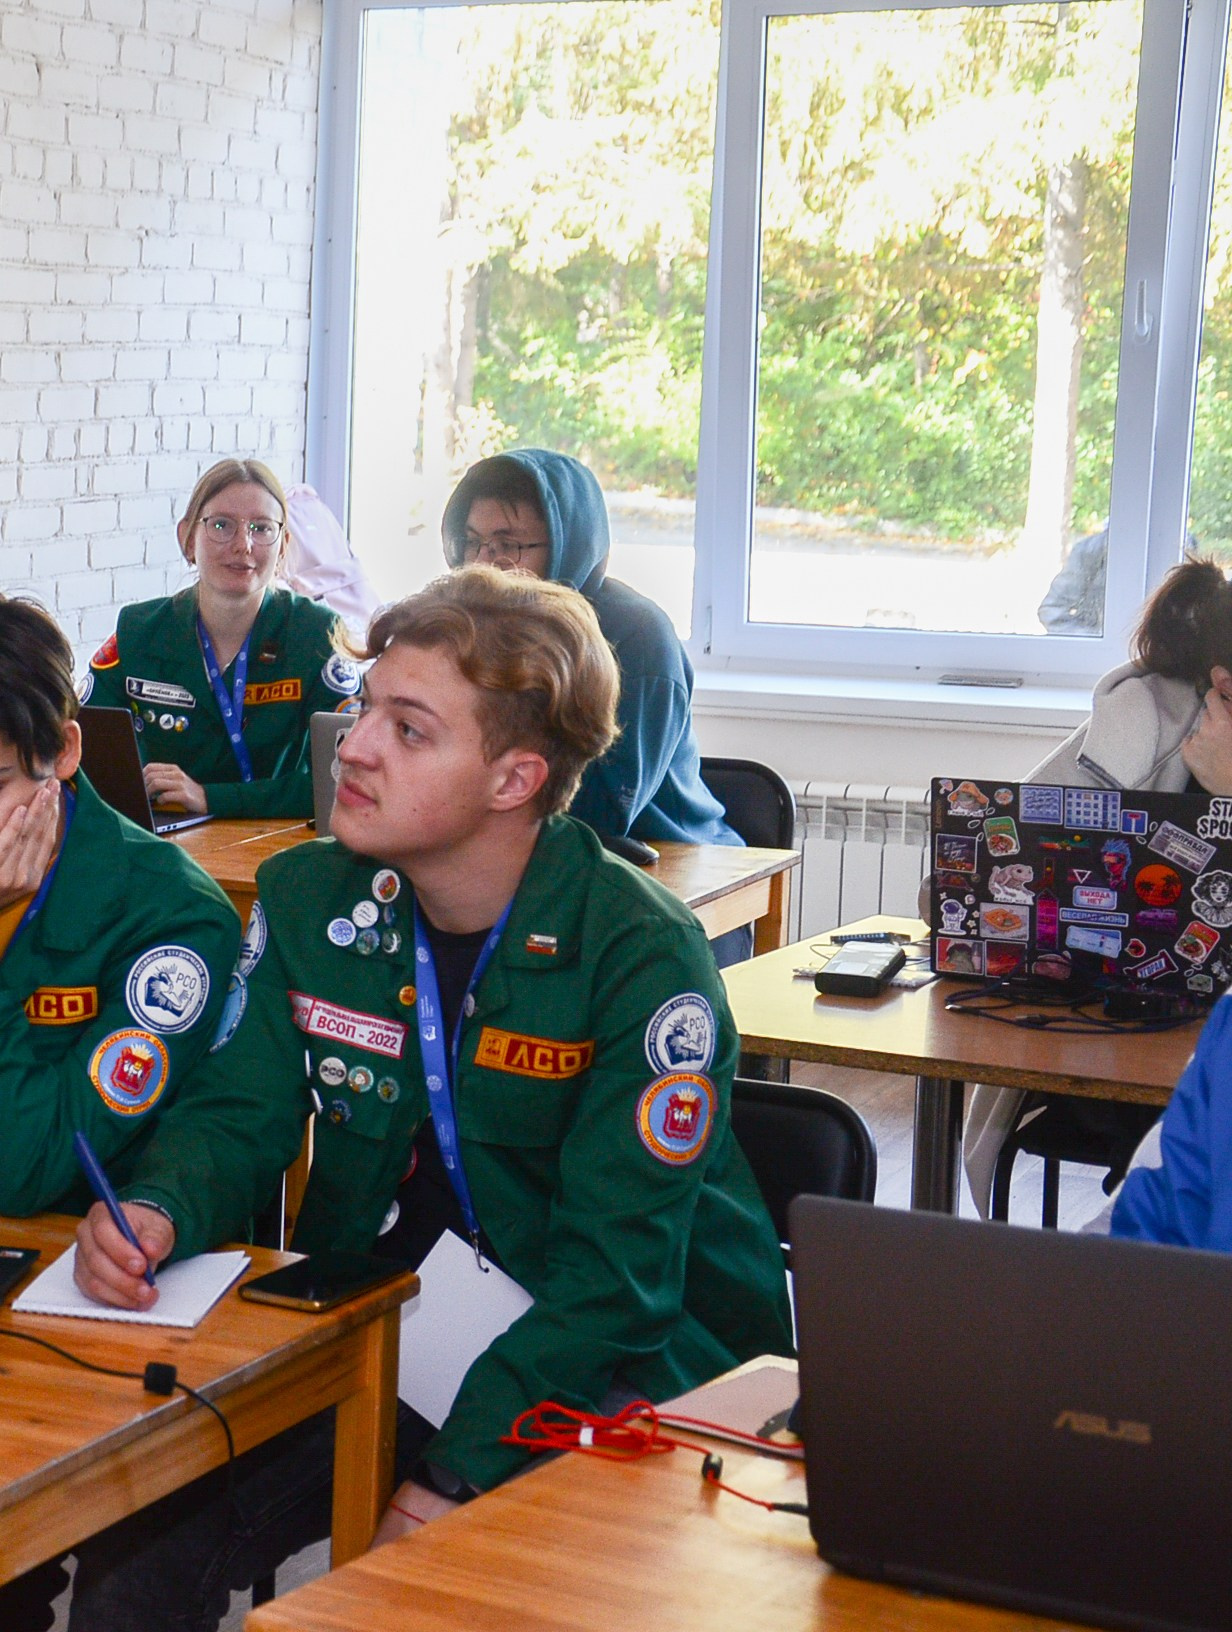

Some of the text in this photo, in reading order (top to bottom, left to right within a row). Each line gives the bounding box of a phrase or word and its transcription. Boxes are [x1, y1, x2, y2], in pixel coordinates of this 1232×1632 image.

[1211, 800, 1232, 817] ST
[175, 973, 197, 991] РСО
[689, 1016, 706, 1031] РСО
[316, 1015, 357, 1039] ВСОП
[367, 1030, 398, 1050] 2022
[511, 1043, 582, 1072] ЛСО
[320, 1065, 345, 1079] РСО
